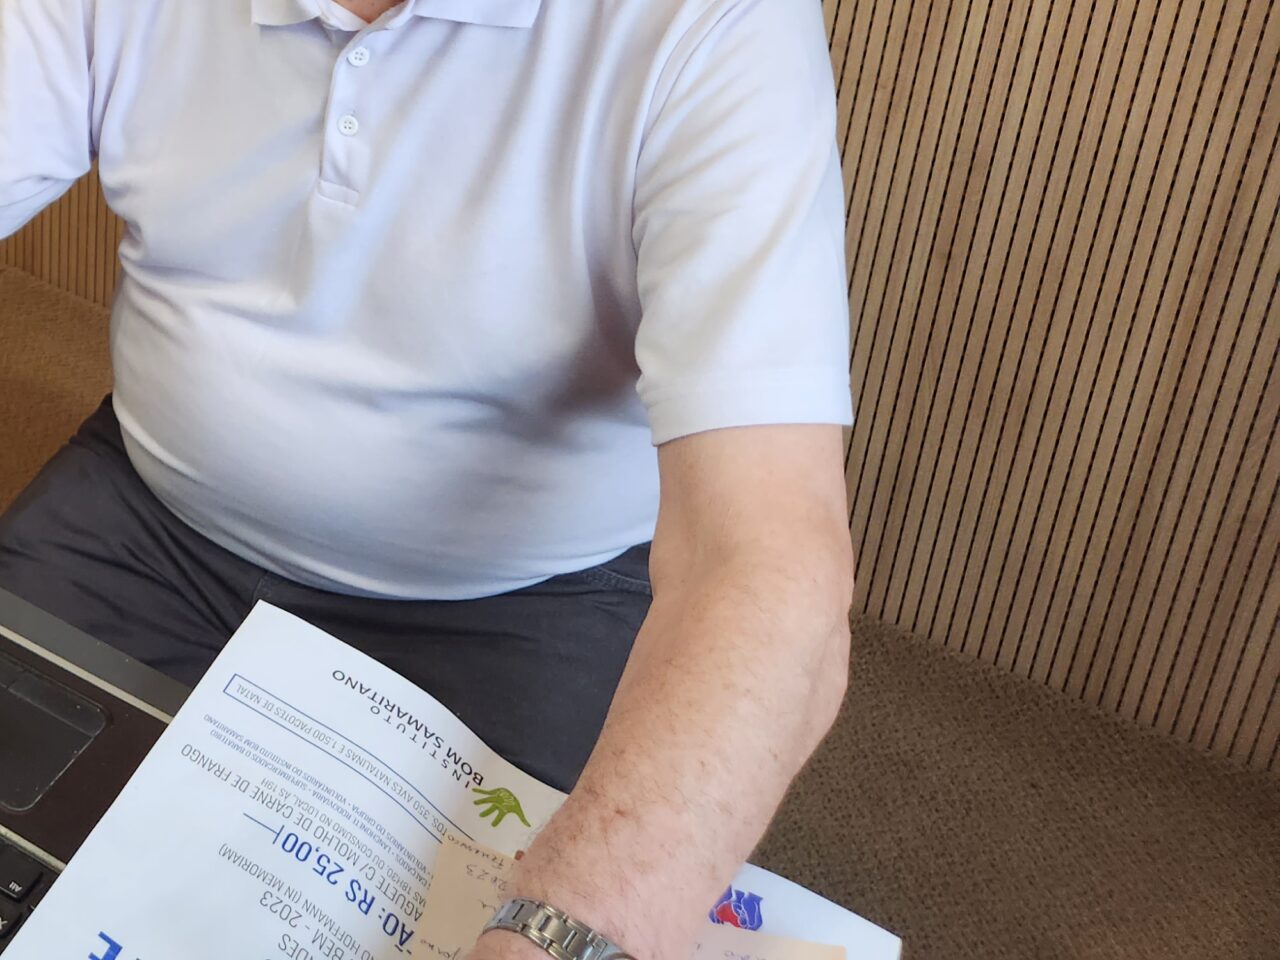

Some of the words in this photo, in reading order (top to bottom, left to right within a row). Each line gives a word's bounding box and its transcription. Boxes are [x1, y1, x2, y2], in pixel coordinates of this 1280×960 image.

[234, 683, 262, 704] NATAL
[330, 667, 444, 748] SAMARITANO
[272, 706, 312, 734] PACOTES
[179, 742, 232, 781] FRANGO
[368, 704, 470, 788] INSTITUTO
[344, 748, 392, 786] NATALINAS
[444, 746, 484, 786] BOM
[230, 774, 250, 793] DE
[260, 777, 278, 792] 19H
[390, 781, 414, 803] AVES
[248, 785, 294, 820] CARNE
[292, 812, 313, 831] DE
[318, 813, 332, 826] NO
[311, 824, 360, 865] MOLHO
[331, 821, 373, 857] CONSUMO
[217, 842, 284, 891] MEMORIAM)
[279, 830, 345, 885] 25,00
[358, 860, 377, 881] C/
[371, 853, 386, 868] OU
[8, 882, 22, 892] Alt
[283, 884, 303, 903] (IN
[257, 889, 302, 928] 2023
[300, 898, 361, 954] HOFFMANN
[309, 928, 345, 960] BEM
